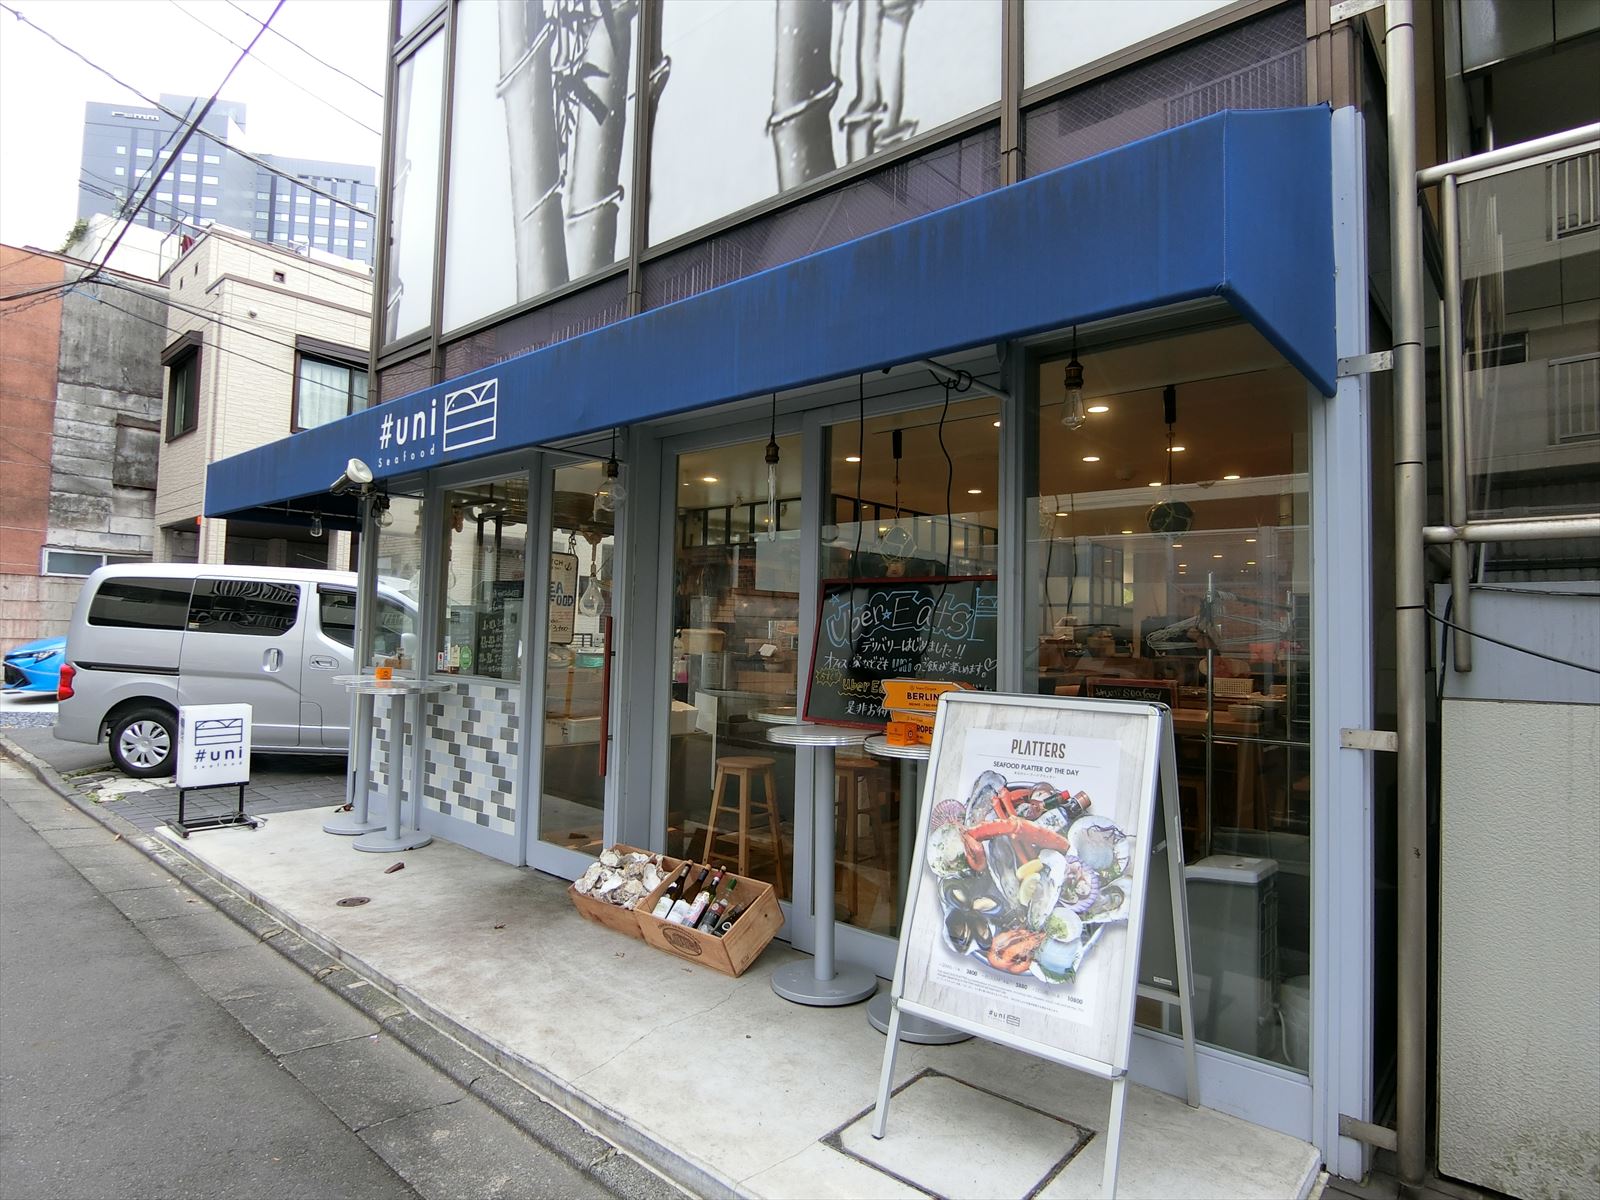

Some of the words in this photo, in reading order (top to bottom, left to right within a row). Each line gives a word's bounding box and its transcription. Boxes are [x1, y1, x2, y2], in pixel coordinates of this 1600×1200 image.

[379, 398, 437, 450] #uni
[378, 443, 435, 468] Seafood
[907, 692, 940, 701] BERLIN
[916, 724, 933, 735] ROPE
[195, 746, 242, 762] #uni
[1011, 738, 1066, 759] PLATTERS
[993, 760, 1020, 770] SEAFOOD
[1021, 763, 1043, 773] PLATTER
[1054, 767, 1065, 775] THE
[1066, 768, 1080, 777] DAY
